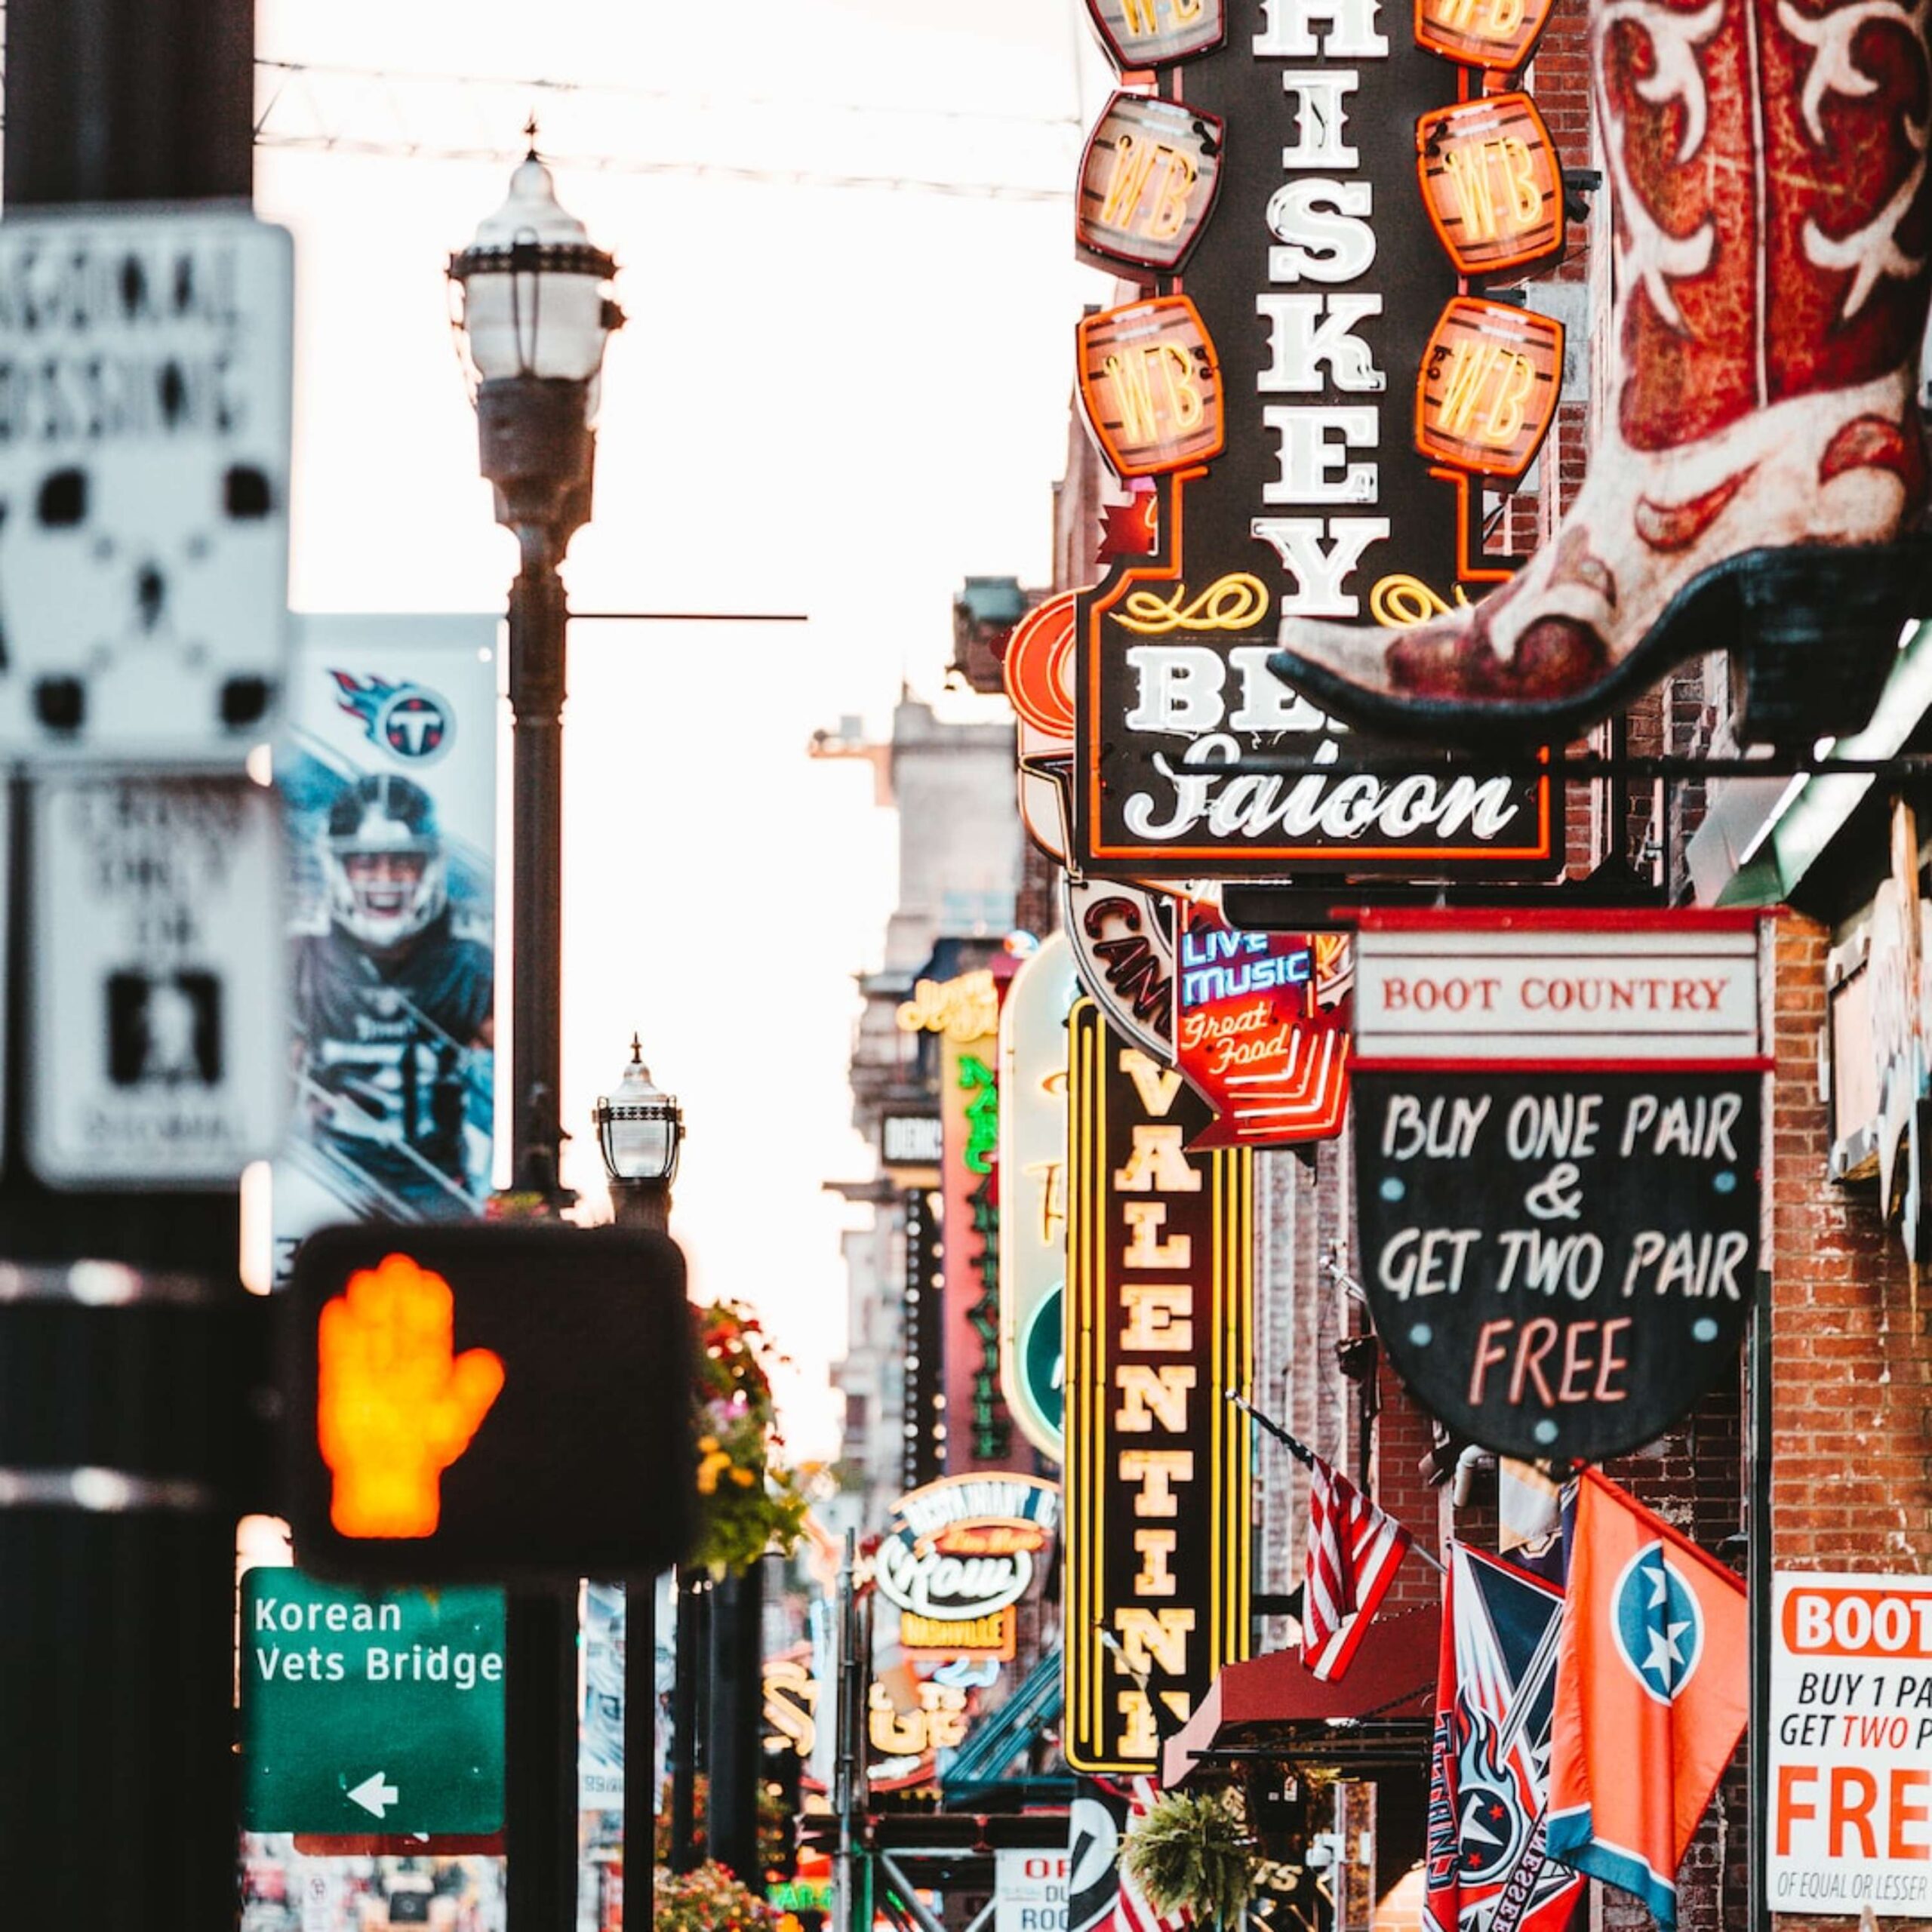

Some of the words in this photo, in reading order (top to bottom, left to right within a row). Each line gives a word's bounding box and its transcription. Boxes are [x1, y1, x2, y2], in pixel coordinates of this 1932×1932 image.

[1100, 134, 1200, 241] WB
[1442, 137, 1543, 240] WB
[1104, 339, 1205, 444] WB
[1438, 339, 1534, 445] WB
[1125, 647, 1349, 732] BE
[1124, 732, 1519, 839] Saloon
[1084, 897, 1173, 1045] CAN
[1183, 931, 1268, 968] LIVE
[1180, 1001, 1268, 1051] Great
[1382, 978, 1500, 1012] BOOT
[1520, 977, 1730, 1012] COUNTRY
[1209, 1023, 1289, 1075] Food
[1381, 1094, 1491, 1161] BUY
[1506, 1094, 1602, 1161] ONE
[1620, 1094, 1742, 1161] PAIR
[1524, 1163, 1583, 1220] &
[1378, 1227, 1481, 1301] GET
[1497, 1229, 1604, 1300] TWO
[1623, 1231, 1748, 1300] PAIR
[1468, 1318, 1632, 1408] FREE
[1114, 1049, 1201, 1758] VALENTINE
[255, 1598, 401, 1632] Korean
[256, 1644, 346, 1681] Vets
[367, 1644, 503, 1690] Bridge
[1798, 1672, 1863, 1705] BUY
[1873, 1676, 1885, 1706] 1
[1781, 1713, 1835, 1747] GET
[1842, 1715, 1909, 1749] TWO
[1777, 1871, 1798, 1897] OF
[1799, 1872, 1847, 1899] EQUAL
[1851, 1873, 1873, 1900] OR
[1875, 1875, 1928, 1901] LESSER
